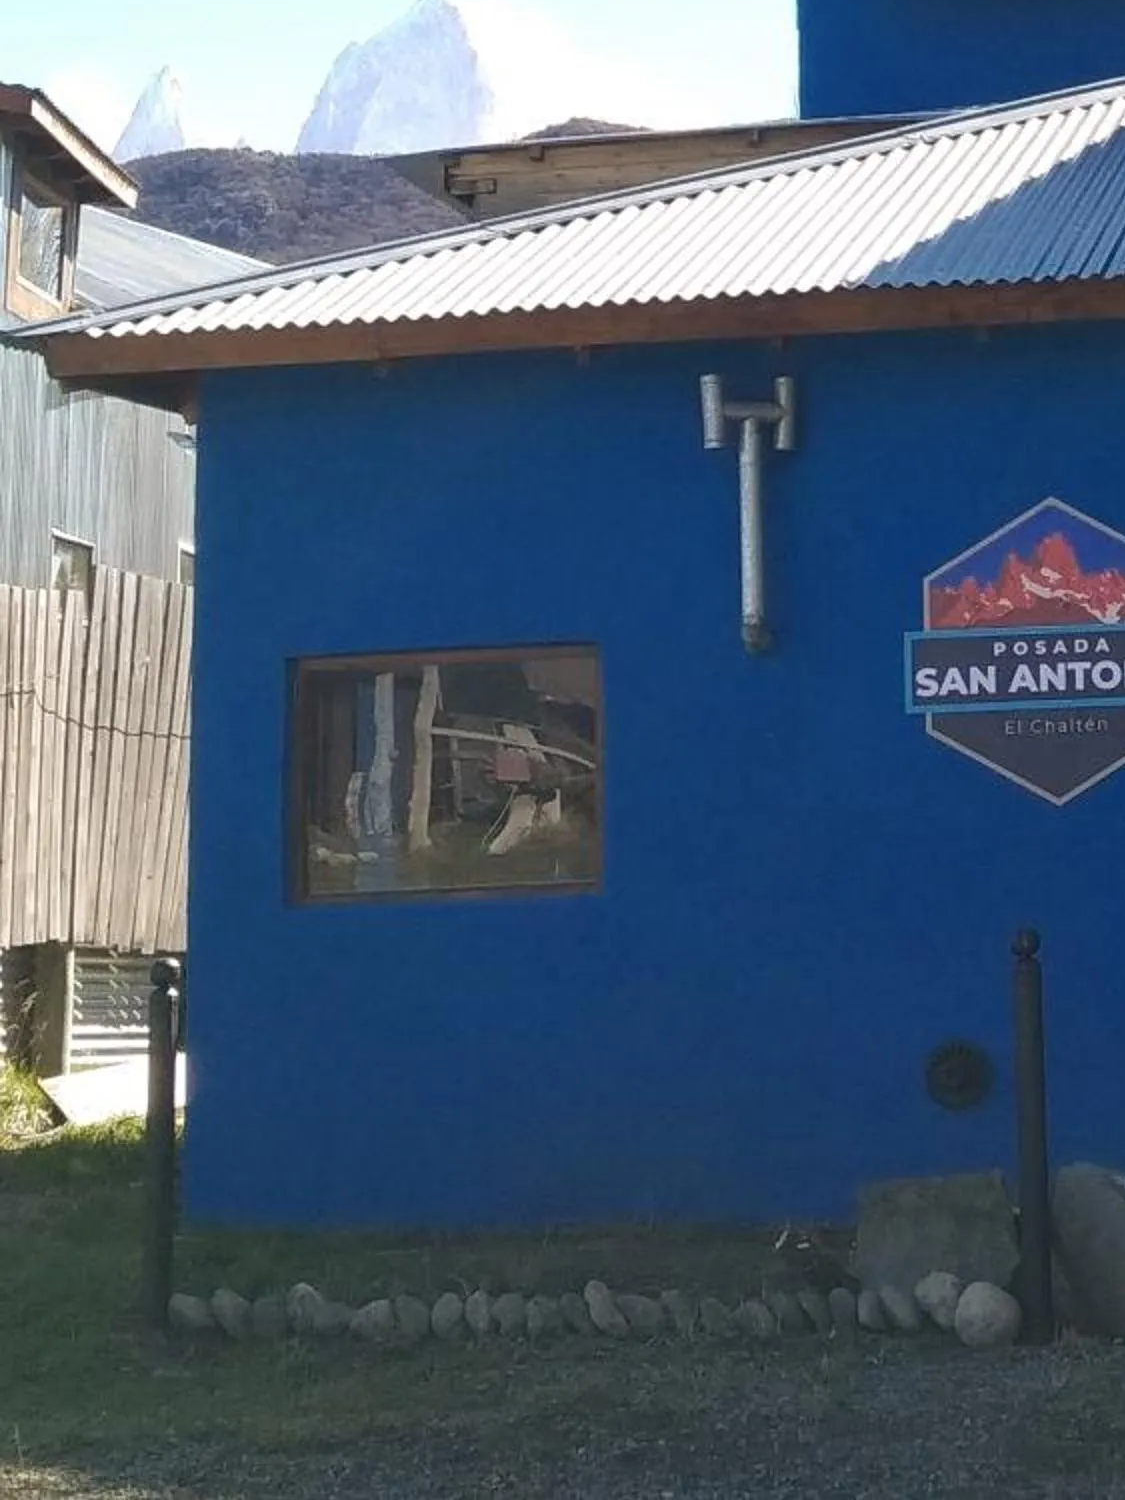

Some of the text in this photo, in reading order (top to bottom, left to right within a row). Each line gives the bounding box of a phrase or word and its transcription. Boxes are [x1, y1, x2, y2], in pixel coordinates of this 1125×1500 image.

[993, 637, 1111, 656] POSADA
[915, 665, 997, 697] SAN
[1004, 720, 1021, 735] El
